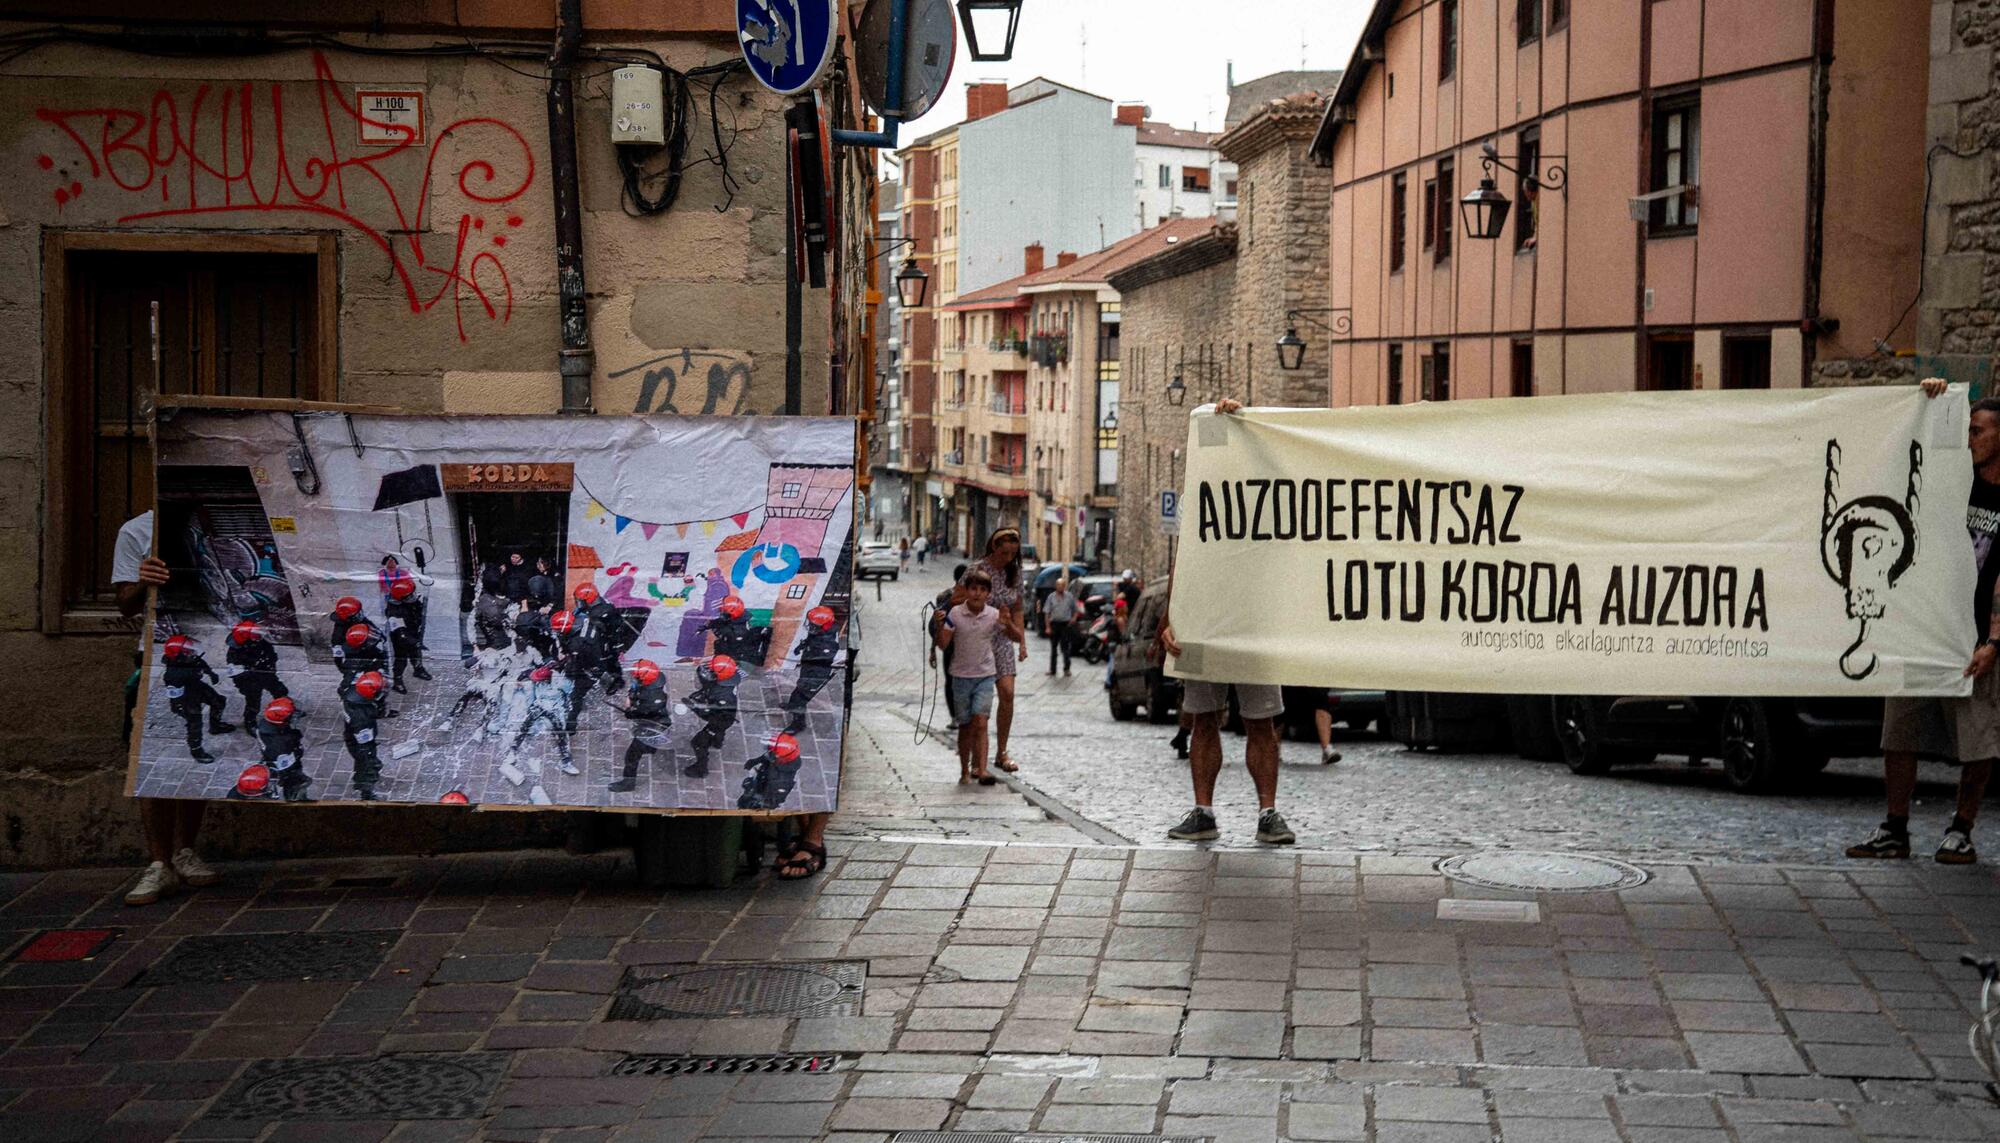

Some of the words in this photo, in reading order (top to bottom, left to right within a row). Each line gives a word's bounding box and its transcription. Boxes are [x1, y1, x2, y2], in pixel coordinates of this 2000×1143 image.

[467, 464, 549, 483] KORDA
[1199, 478, 1525, 546] AUZODEFENTSAZ
[1326, 558, 1426, 622] LOTU
[1440, 559, 1582, 624] KORDA
[1599, 564, 1769, 632] AUZORA
[1461, 628, 1544, 651] autogestioa
[1556, 629, 1653, 656] elkarlaguntza
[1665, 633, 1768, 658] auzodefentsa
